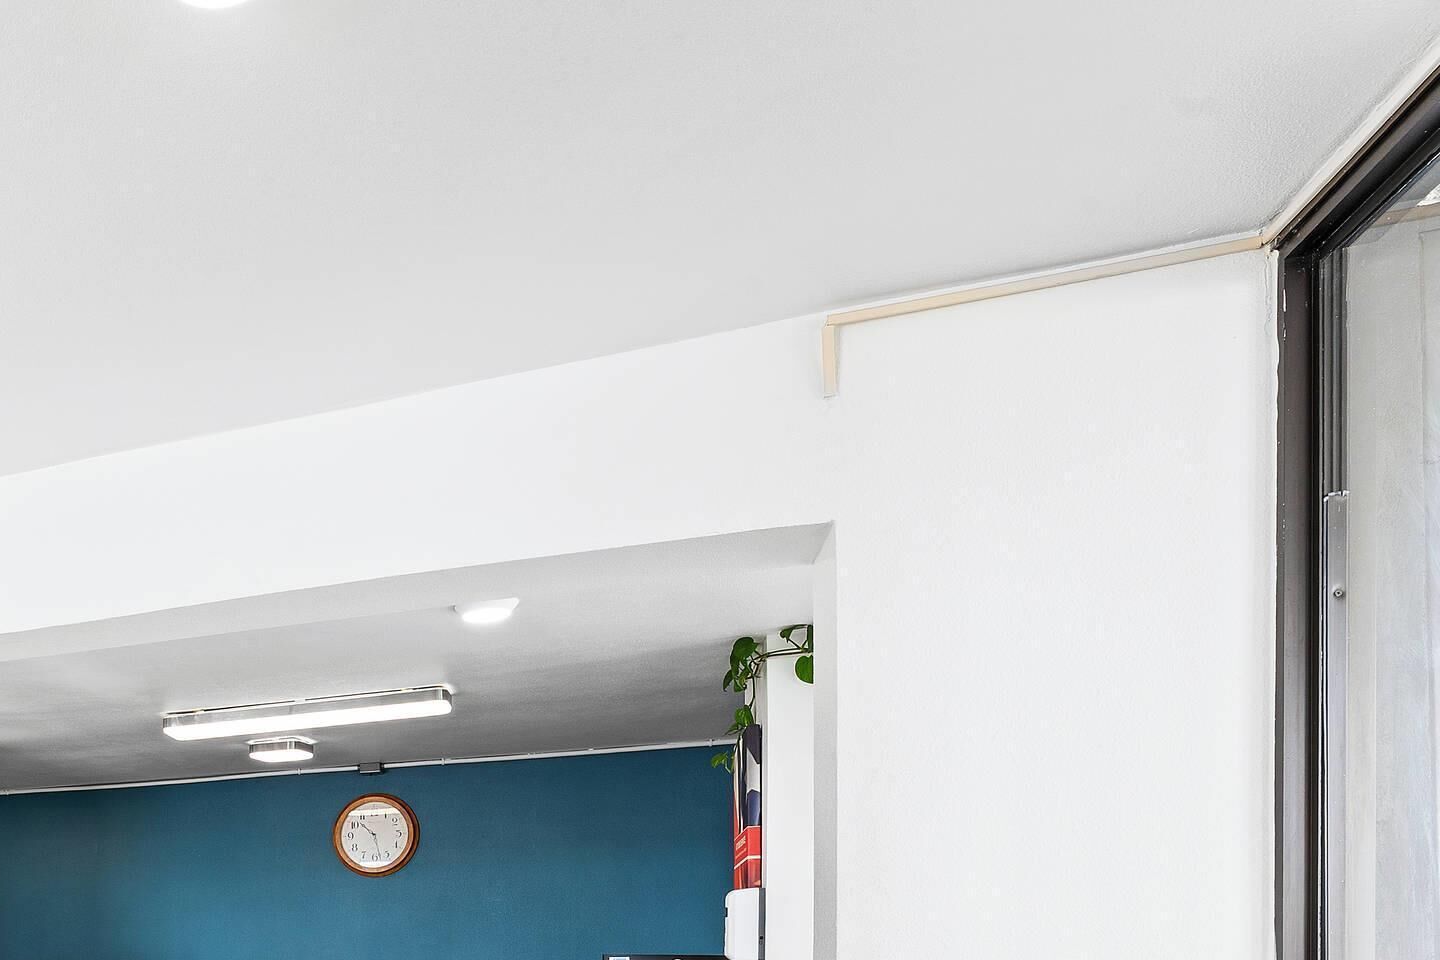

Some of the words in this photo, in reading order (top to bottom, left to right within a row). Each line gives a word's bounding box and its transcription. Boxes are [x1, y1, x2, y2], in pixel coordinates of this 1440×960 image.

[351, 821, 359, 829] 10
[347, 832, 354, 840] 9
[351, 843, 358, 851] 8
[361, 851, 366, 859] 7
[384, 851, 390, 859] 5
